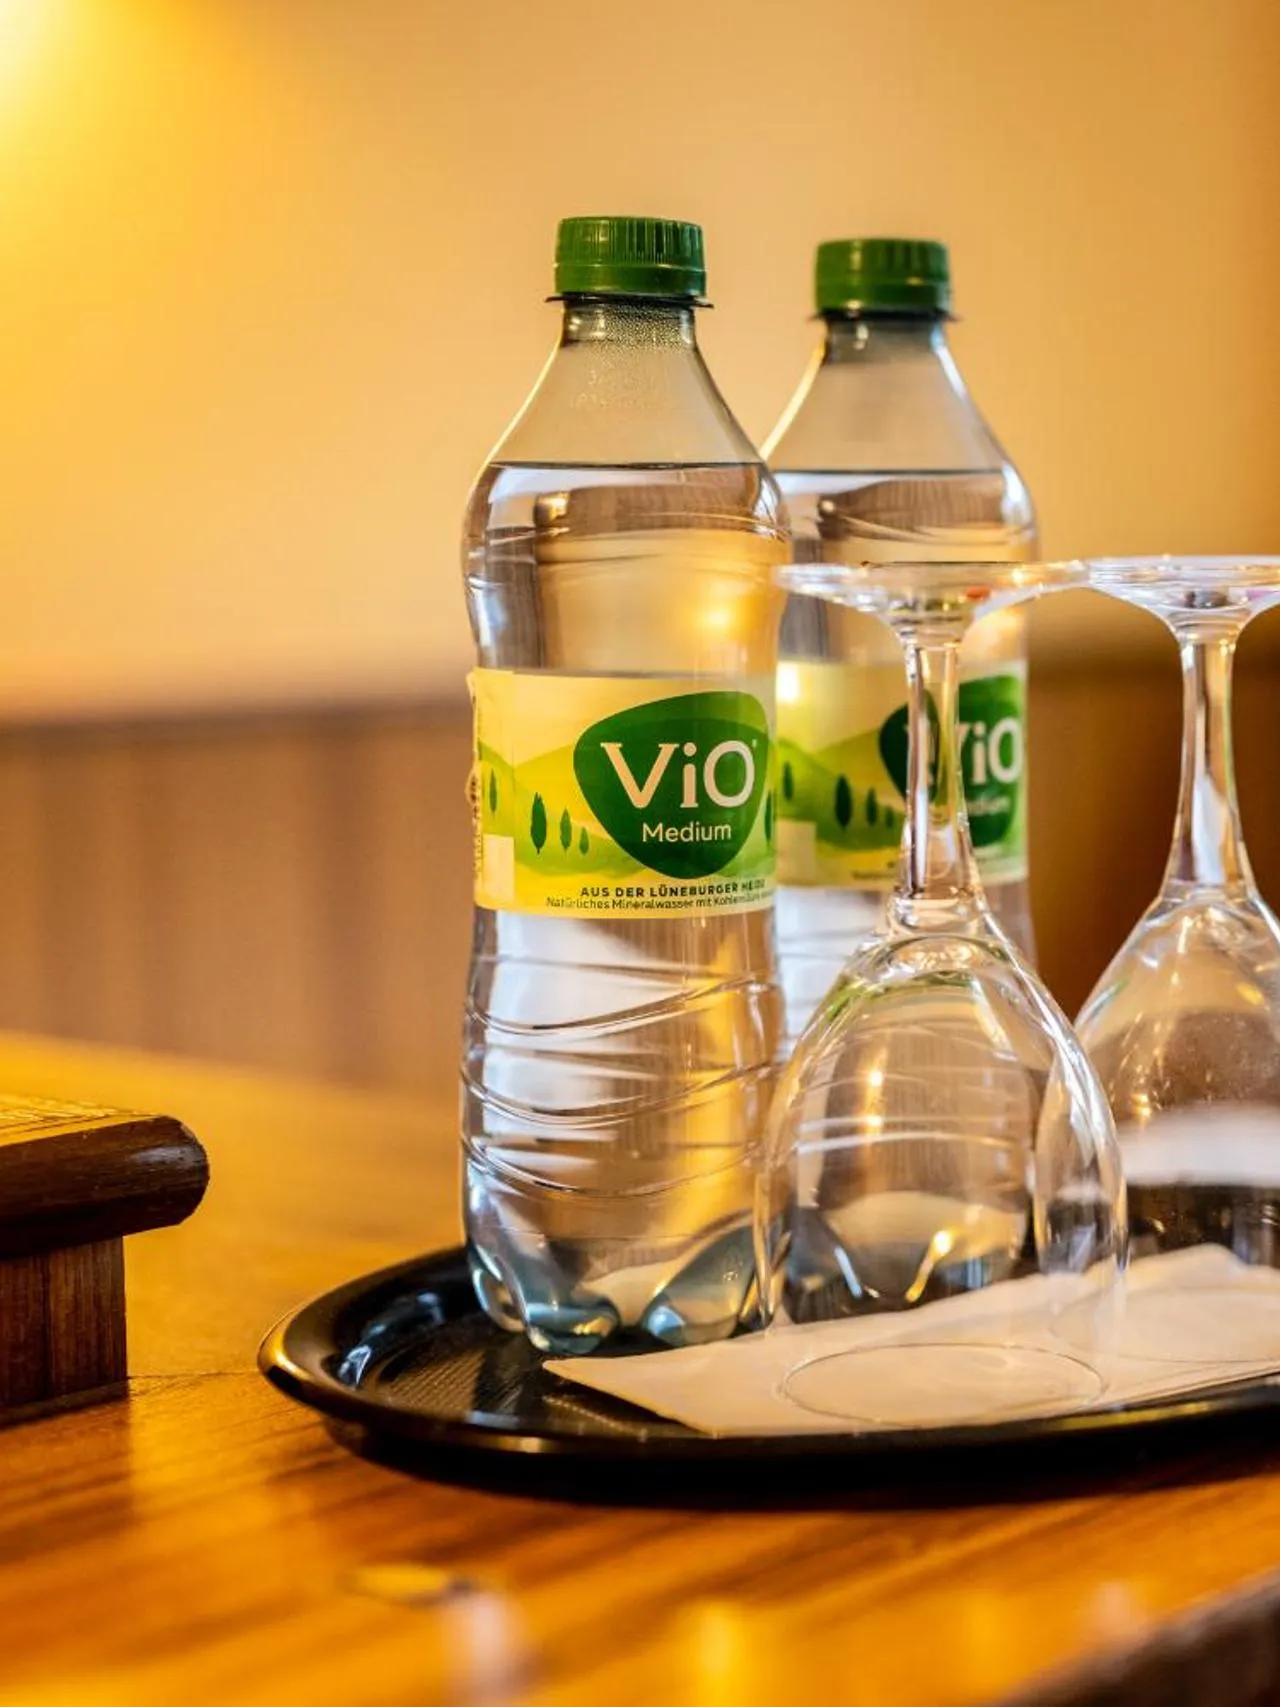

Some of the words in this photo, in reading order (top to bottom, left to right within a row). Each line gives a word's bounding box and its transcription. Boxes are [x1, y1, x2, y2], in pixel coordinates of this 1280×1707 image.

[600, 740, 756, 809] ViO
[642, 822, 732, 842] Medium
[580, 887, 610, 897] AUS
[615, 887, 645, 897] DER
[649, 882, 738, 898] LÜNEBURGER
[612, 898, 694, 909] Mineralwasser
